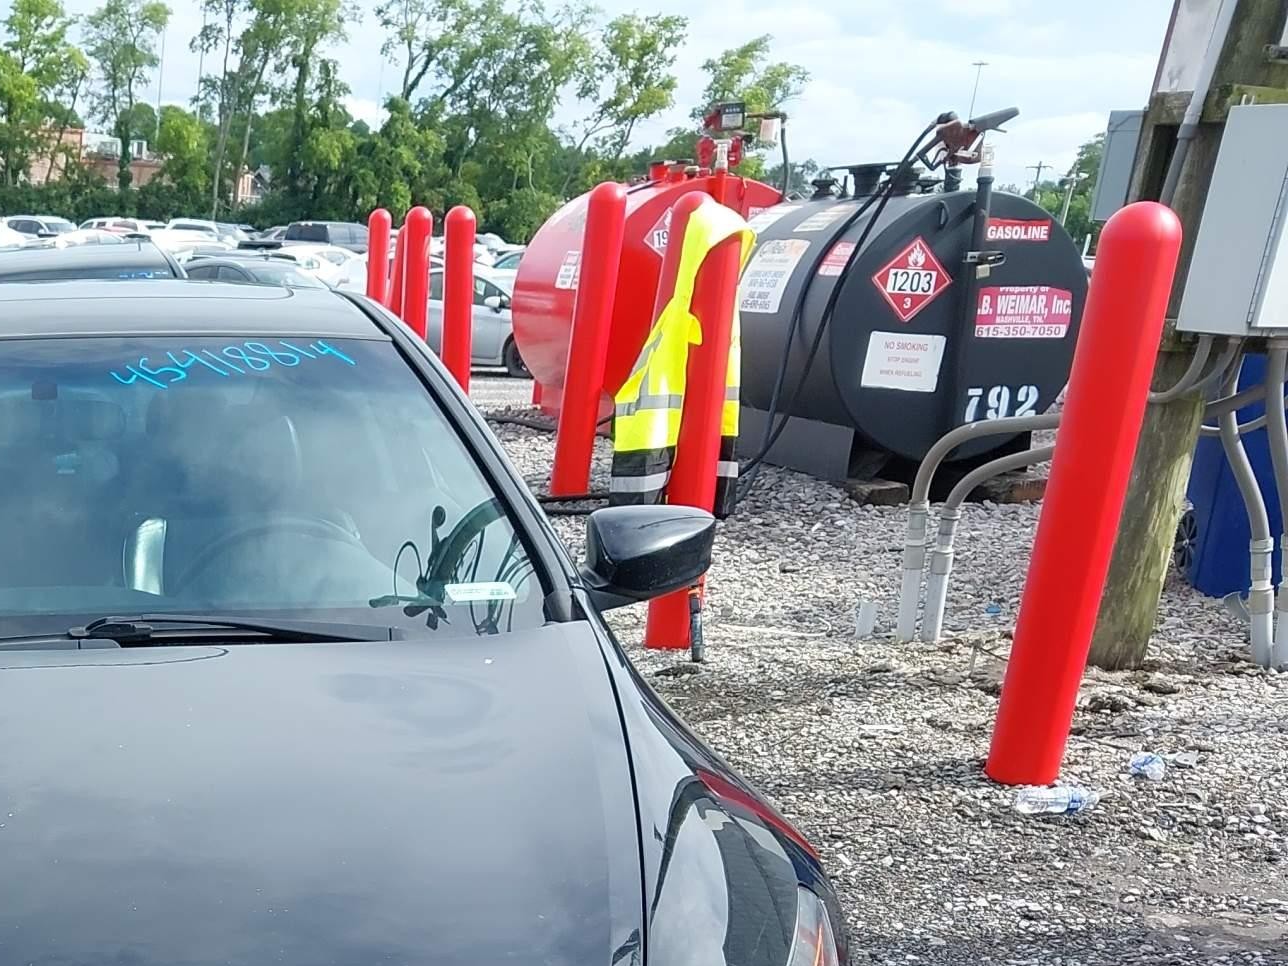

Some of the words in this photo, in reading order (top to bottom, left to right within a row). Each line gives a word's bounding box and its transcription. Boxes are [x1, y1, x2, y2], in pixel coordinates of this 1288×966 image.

[655, 230, 669, 247] 19
[987, 225, 1049, 239] GASOLINE
[891, 271, 933, 293] 1203
[903, 297, 912, 309] 3
[977, 295, 993, 315] .B.
[997, 295, 1049, 318] WEIMAR,
[976, 326, 1061, 337] 615-350-7050
[884, 340, 896, 350] NO
[896, 341, 929, 352] SMOKING
[110, 340, 356, 389] 45418814
[964, 385, 1039, 423] 792
